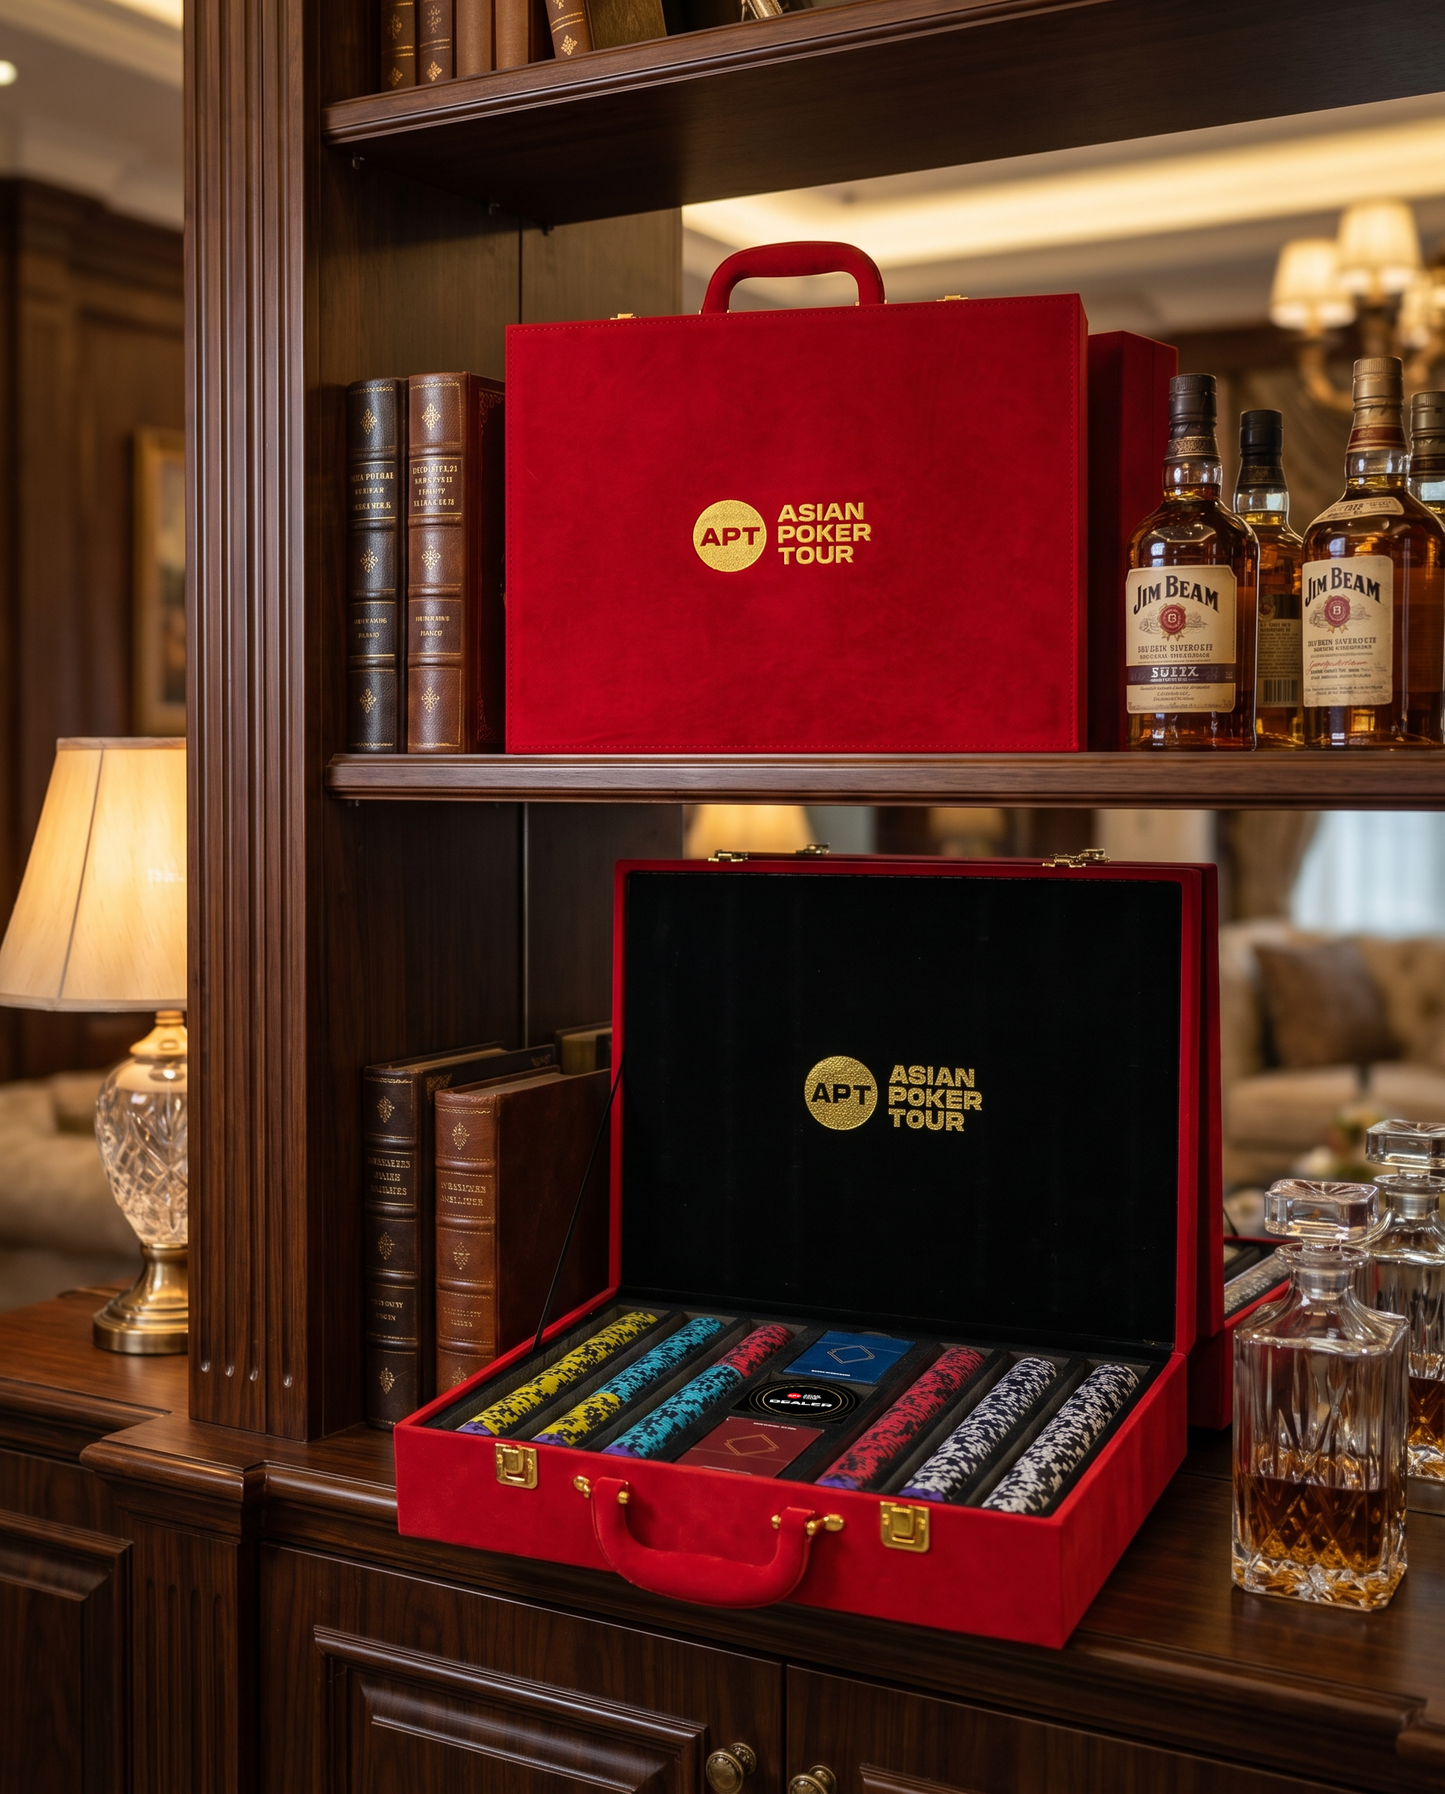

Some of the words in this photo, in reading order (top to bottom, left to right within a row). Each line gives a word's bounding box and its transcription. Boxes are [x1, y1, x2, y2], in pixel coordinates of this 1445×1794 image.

[777, 502, 865, 522] ASIAN
[700, 526, 760, 546] APT
[777, 523, 872, 543] POKER
[777, 545, 854, 565] TOUR
[1133, 582, 1162, 615] JIM
[1164, 575, 1220, 614] BEAM
[1305, 573, 1328, 607] JIM
[1330, 567, 1381, 604] BEAM
[888, 1064, 976, 1088] ASIAN
[811, 1082, 871, 1105] APT
[888, 1085, 983, 1111] POKER
[888, 1107, 965, 1132] TOUR
[769, 1398, 833, 1408] DEALER
